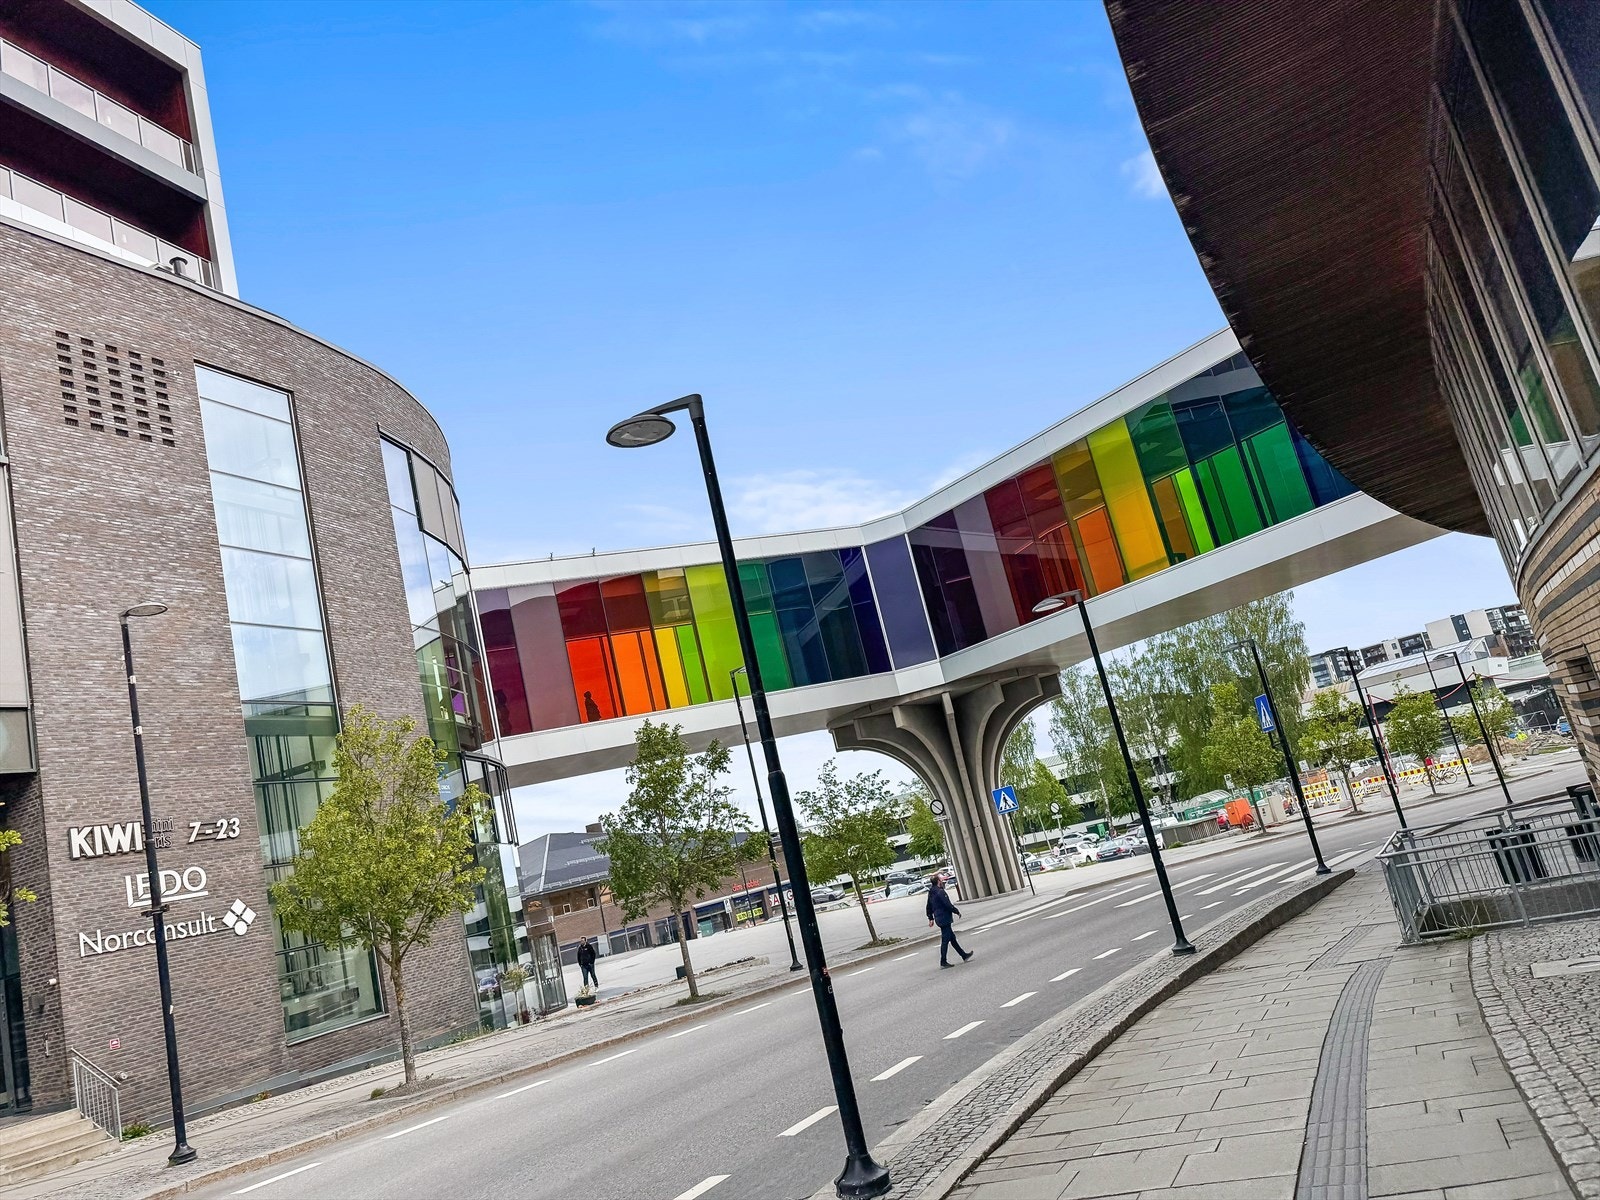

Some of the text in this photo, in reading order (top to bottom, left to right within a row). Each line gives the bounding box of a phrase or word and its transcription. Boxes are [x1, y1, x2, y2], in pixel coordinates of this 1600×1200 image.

[69, 822, 144, 859] KIWI
[154, 833, 172, 848] ris
[78, 911, 217, 957] Norconsult
